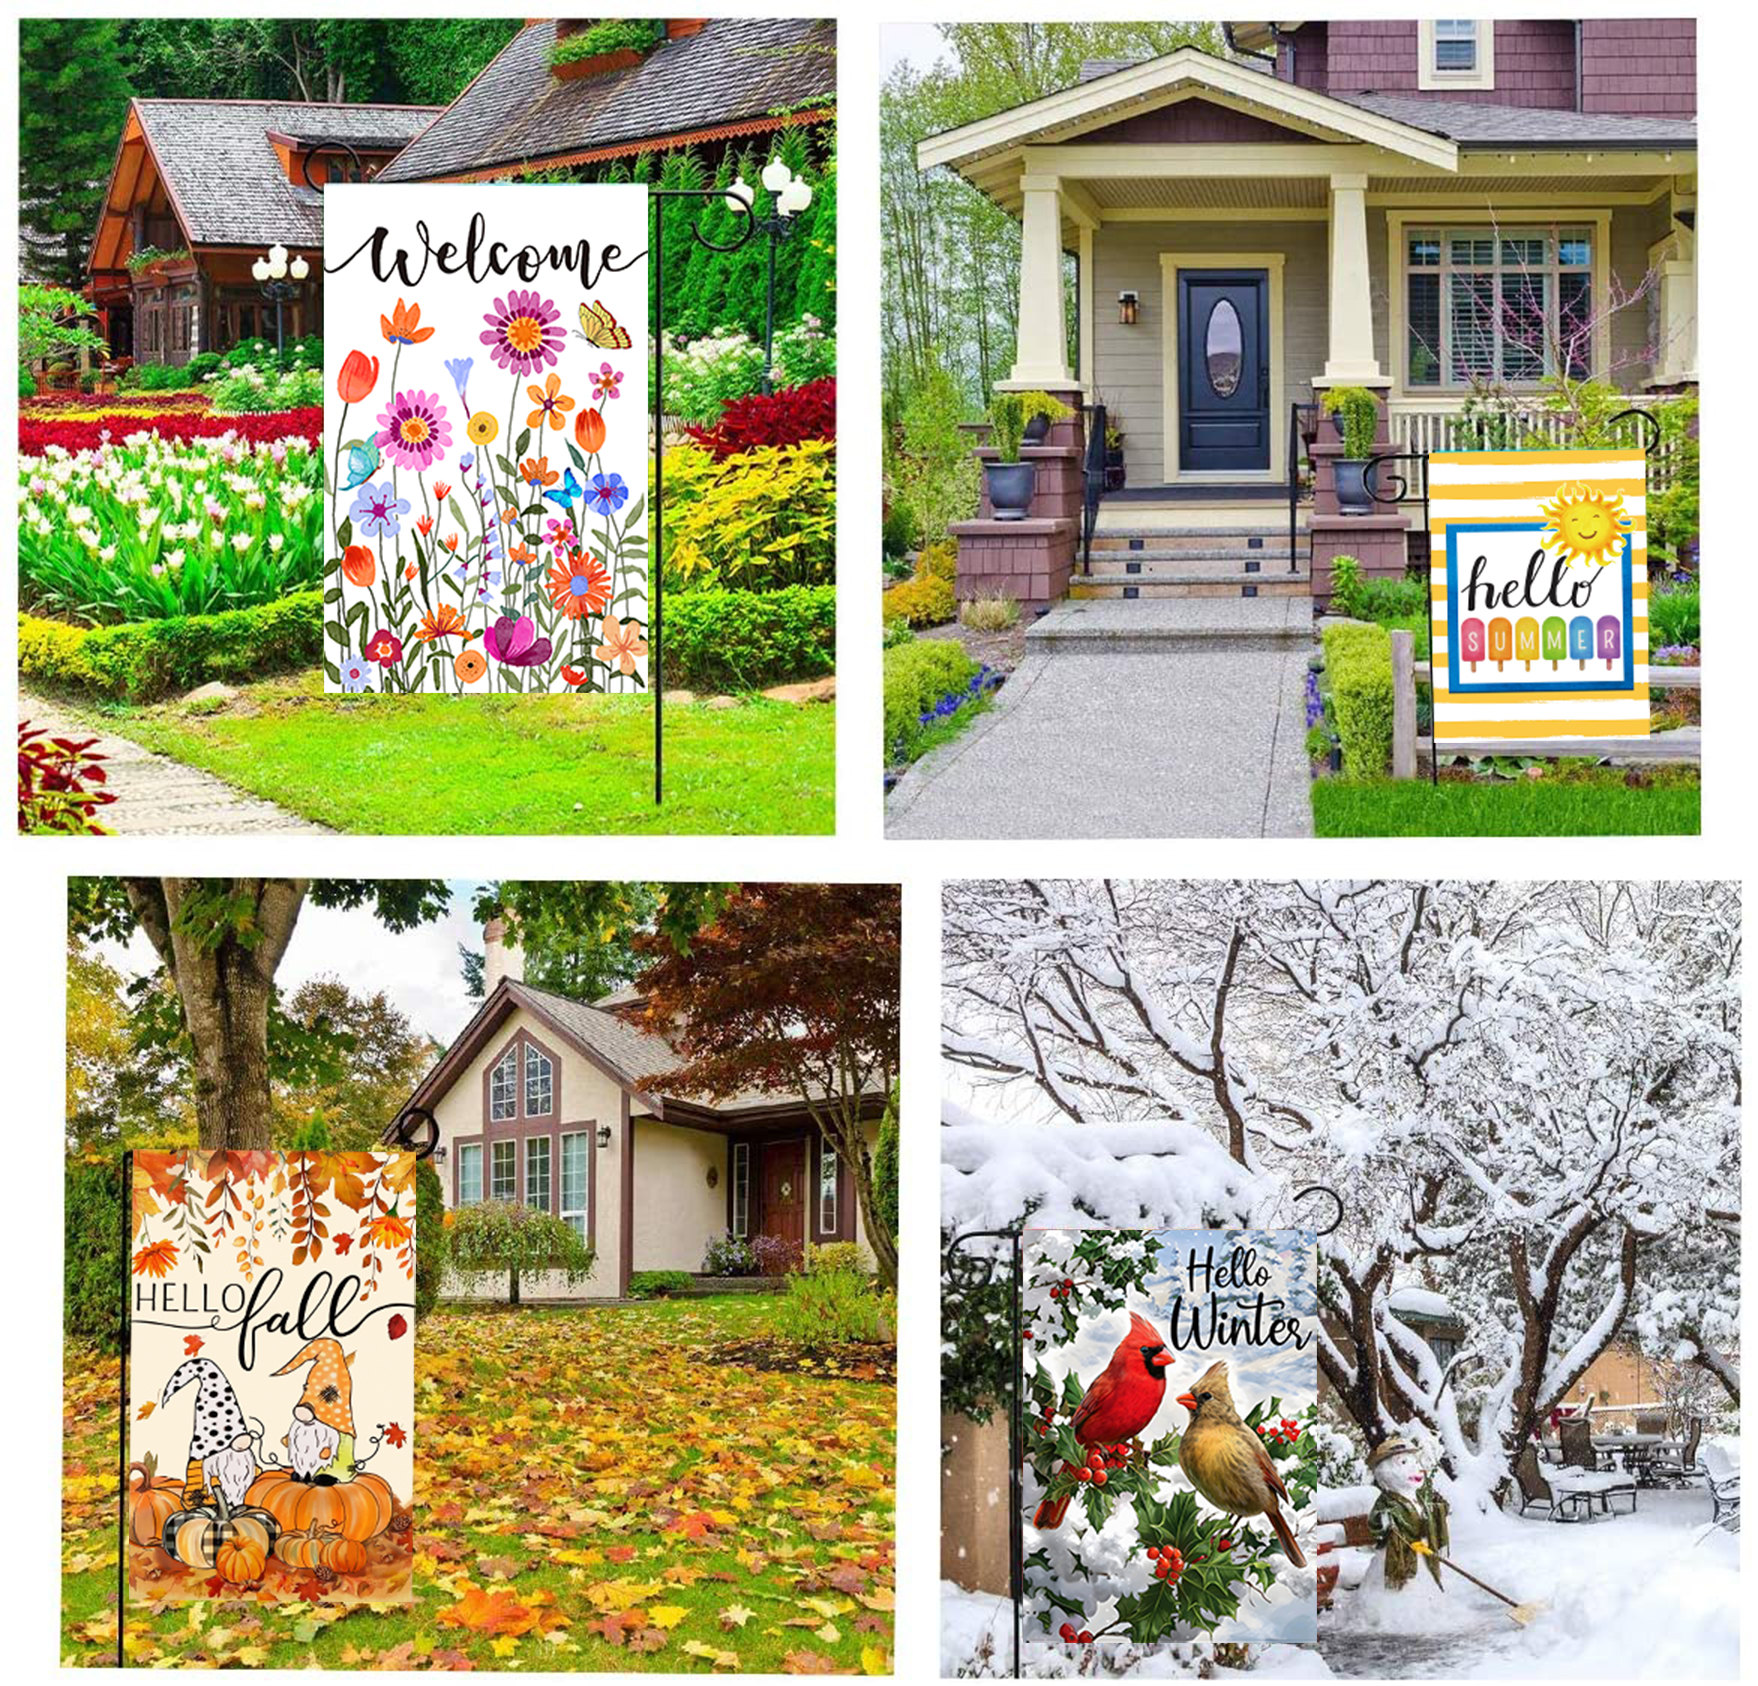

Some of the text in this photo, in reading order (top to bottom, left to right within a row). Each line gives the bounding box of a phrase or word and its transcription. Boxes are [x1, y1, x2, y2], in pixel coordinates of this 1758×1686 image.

[324, 212, 648, 289] Welcome
[1461, 550, 1602, 611] hello
[1468, 627, 1615, 653] SUMMER
[1186, 1245, 1272, 1293] Hello
[135, 1266, 415, 1371] HELLO fall
[1169, 1292, 1313, 1352] Winter
